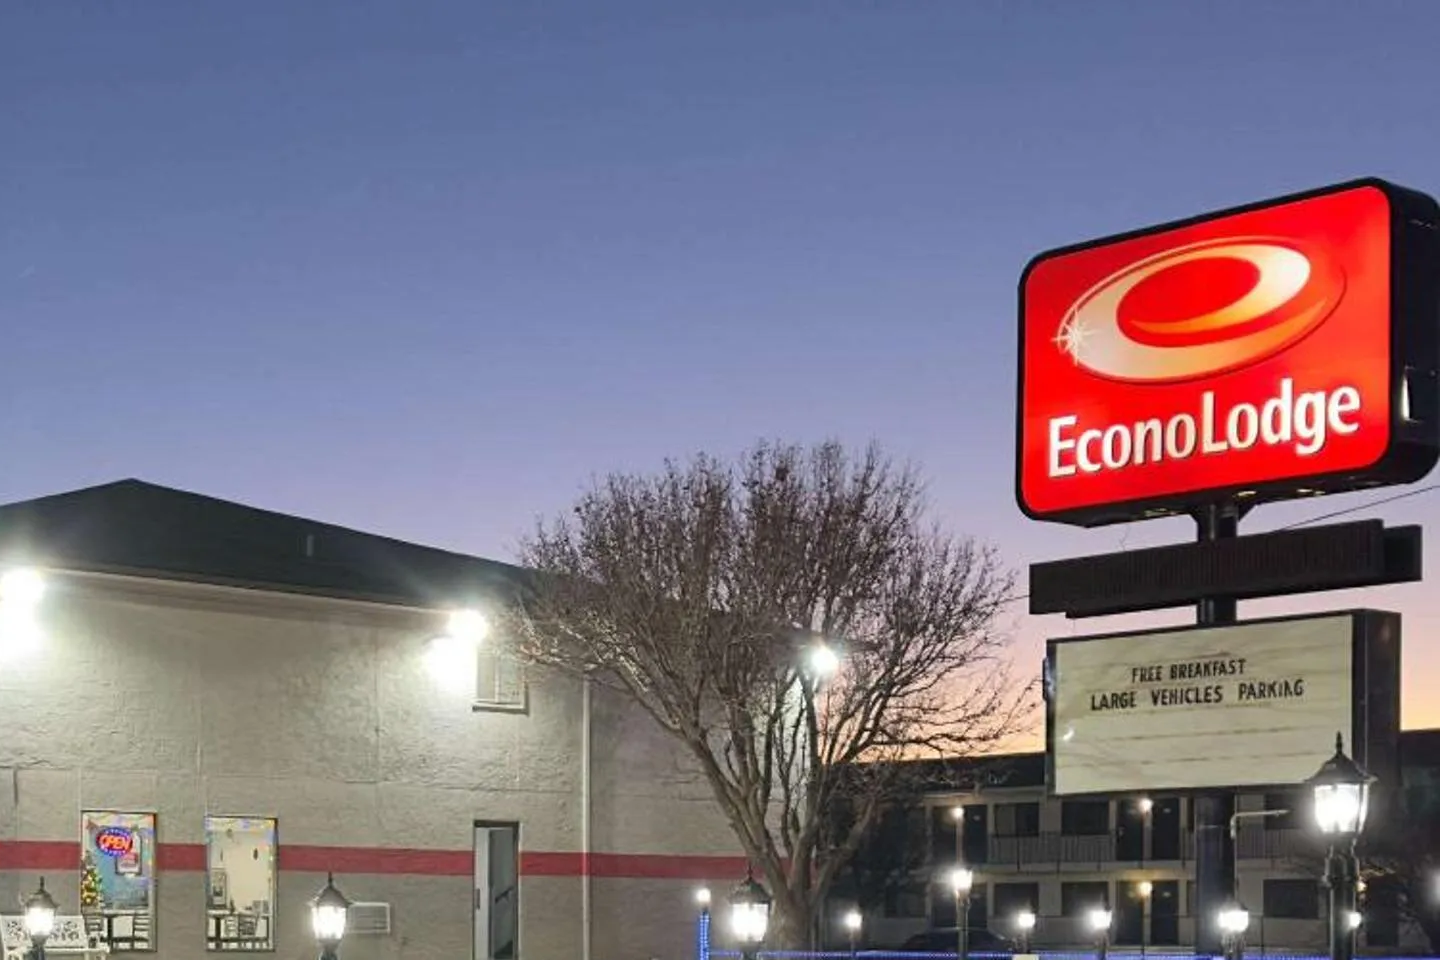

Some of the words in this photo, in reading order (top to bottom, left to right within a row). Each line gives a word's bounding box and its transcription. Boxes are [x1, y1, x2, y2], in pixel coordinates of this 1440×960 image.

[1132, 666, 1162, 684] FREE
[1170, 658, 1247, 680] BREAKFAST
[1091, 693, 1137, 712] LARGE
[1151, 686, 1224, 707] VEHICLES
[1238, 679, 1304, 700] PARKING
[100, 834, 131, 852] OPEN
